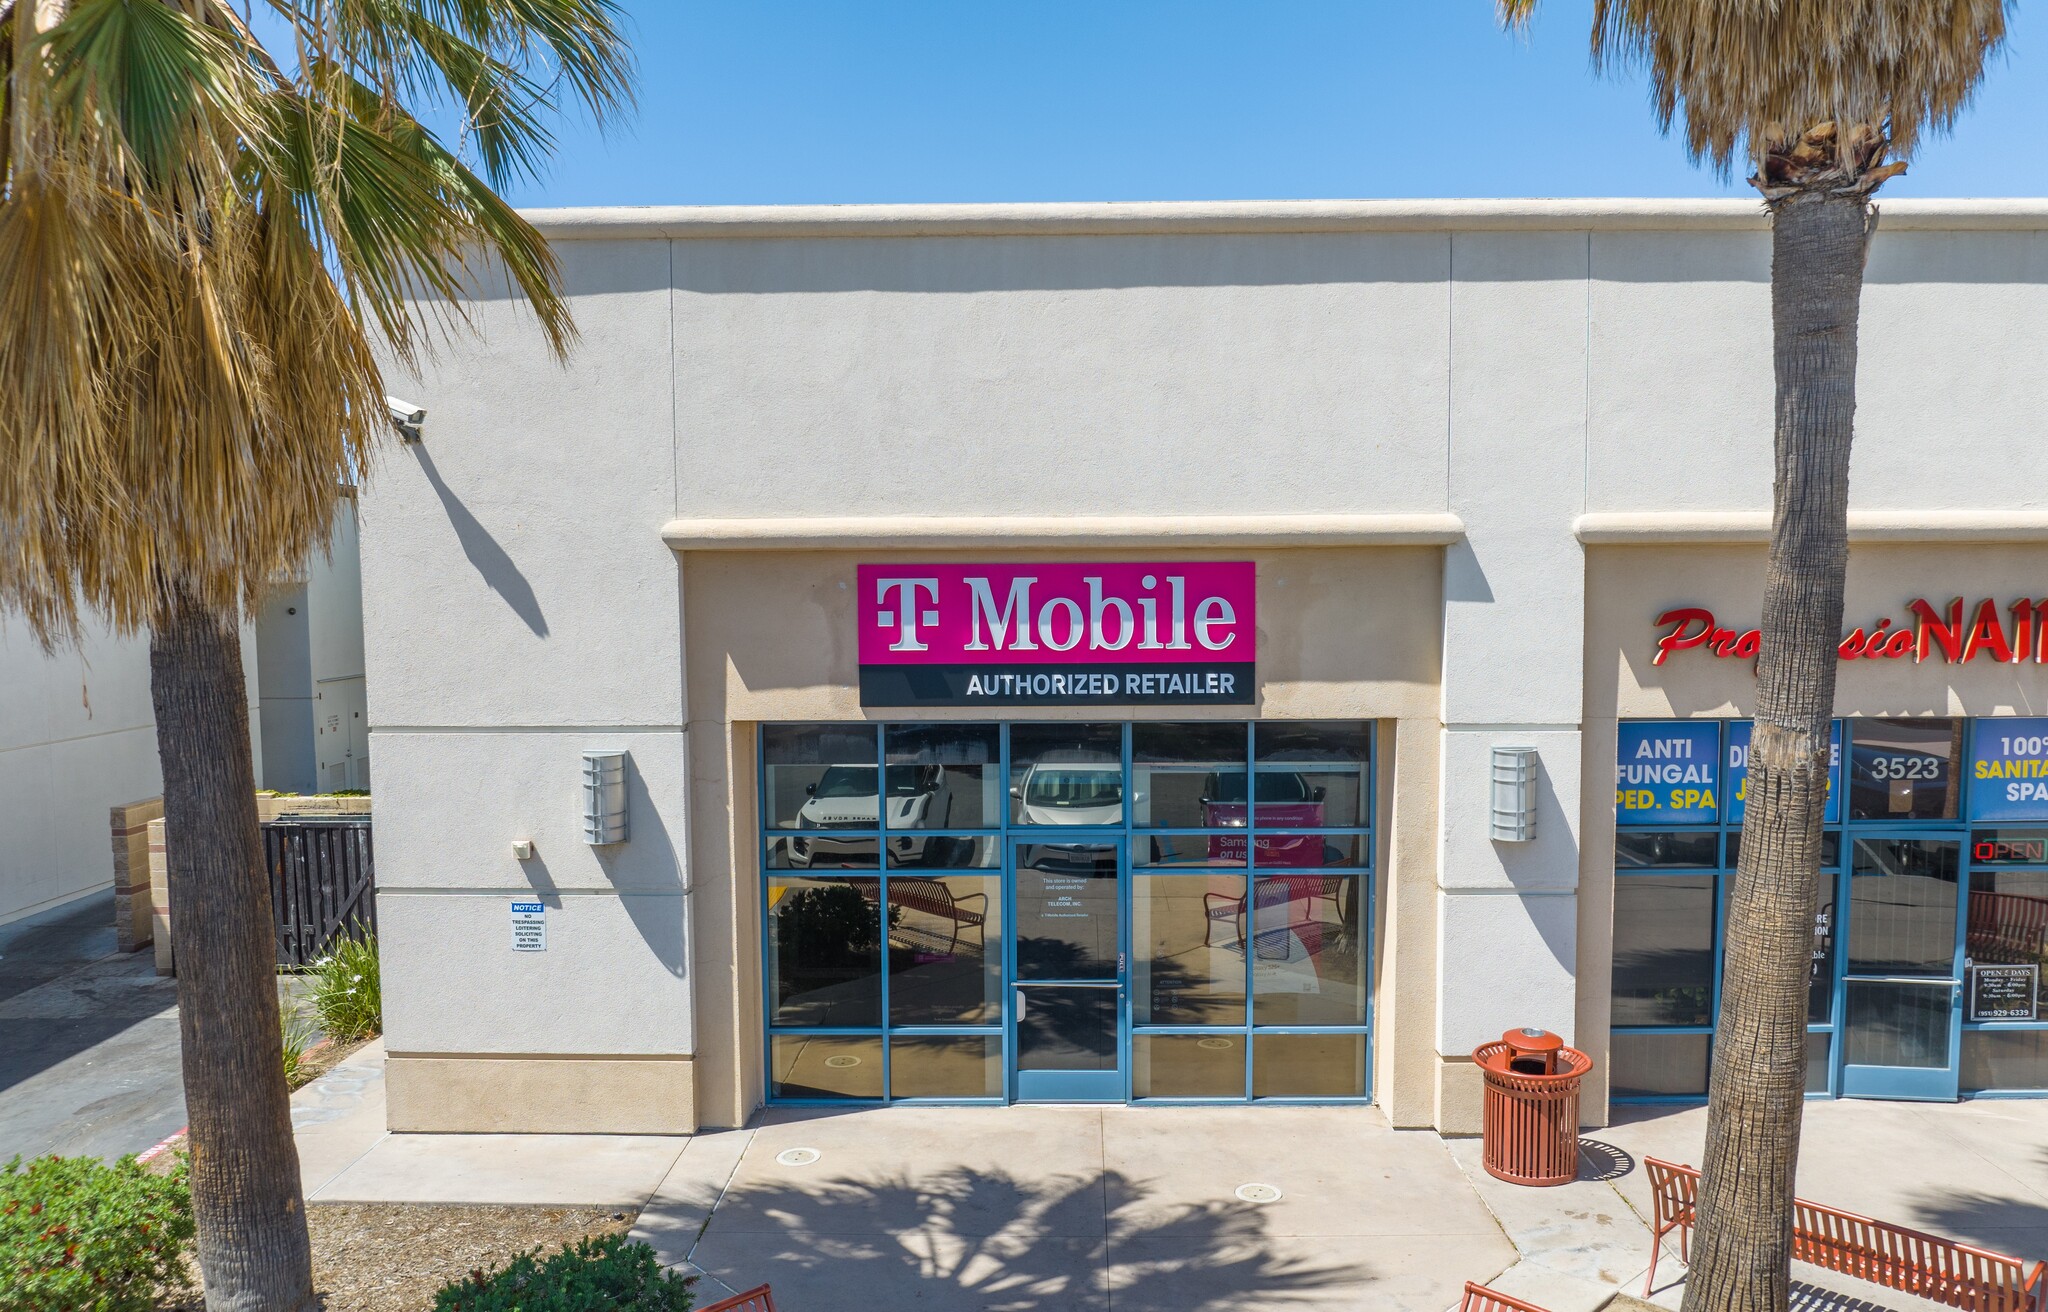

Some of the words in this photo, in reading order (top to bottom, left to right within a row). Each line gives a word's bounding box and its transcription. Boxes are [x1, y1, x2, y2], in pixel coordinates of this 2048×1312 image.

[963, 575, 1237, 651] Mobile
[966, 674, 1120, 696] AUTHORIZED
[1125, 673, 1235, 694] RETAILER
[1635, 739, 1692, 759] ANTI
[1617, 764, 1713, 784] FUNGAL
[1872, 757, 1939, 779] 3523
[1670, 789, 1717, 809] SPA
[2006, 782, 2048, 802] SPA
[1220, 851, 1233, 859] on
[1975, 843, 2042, 859] OPEN
